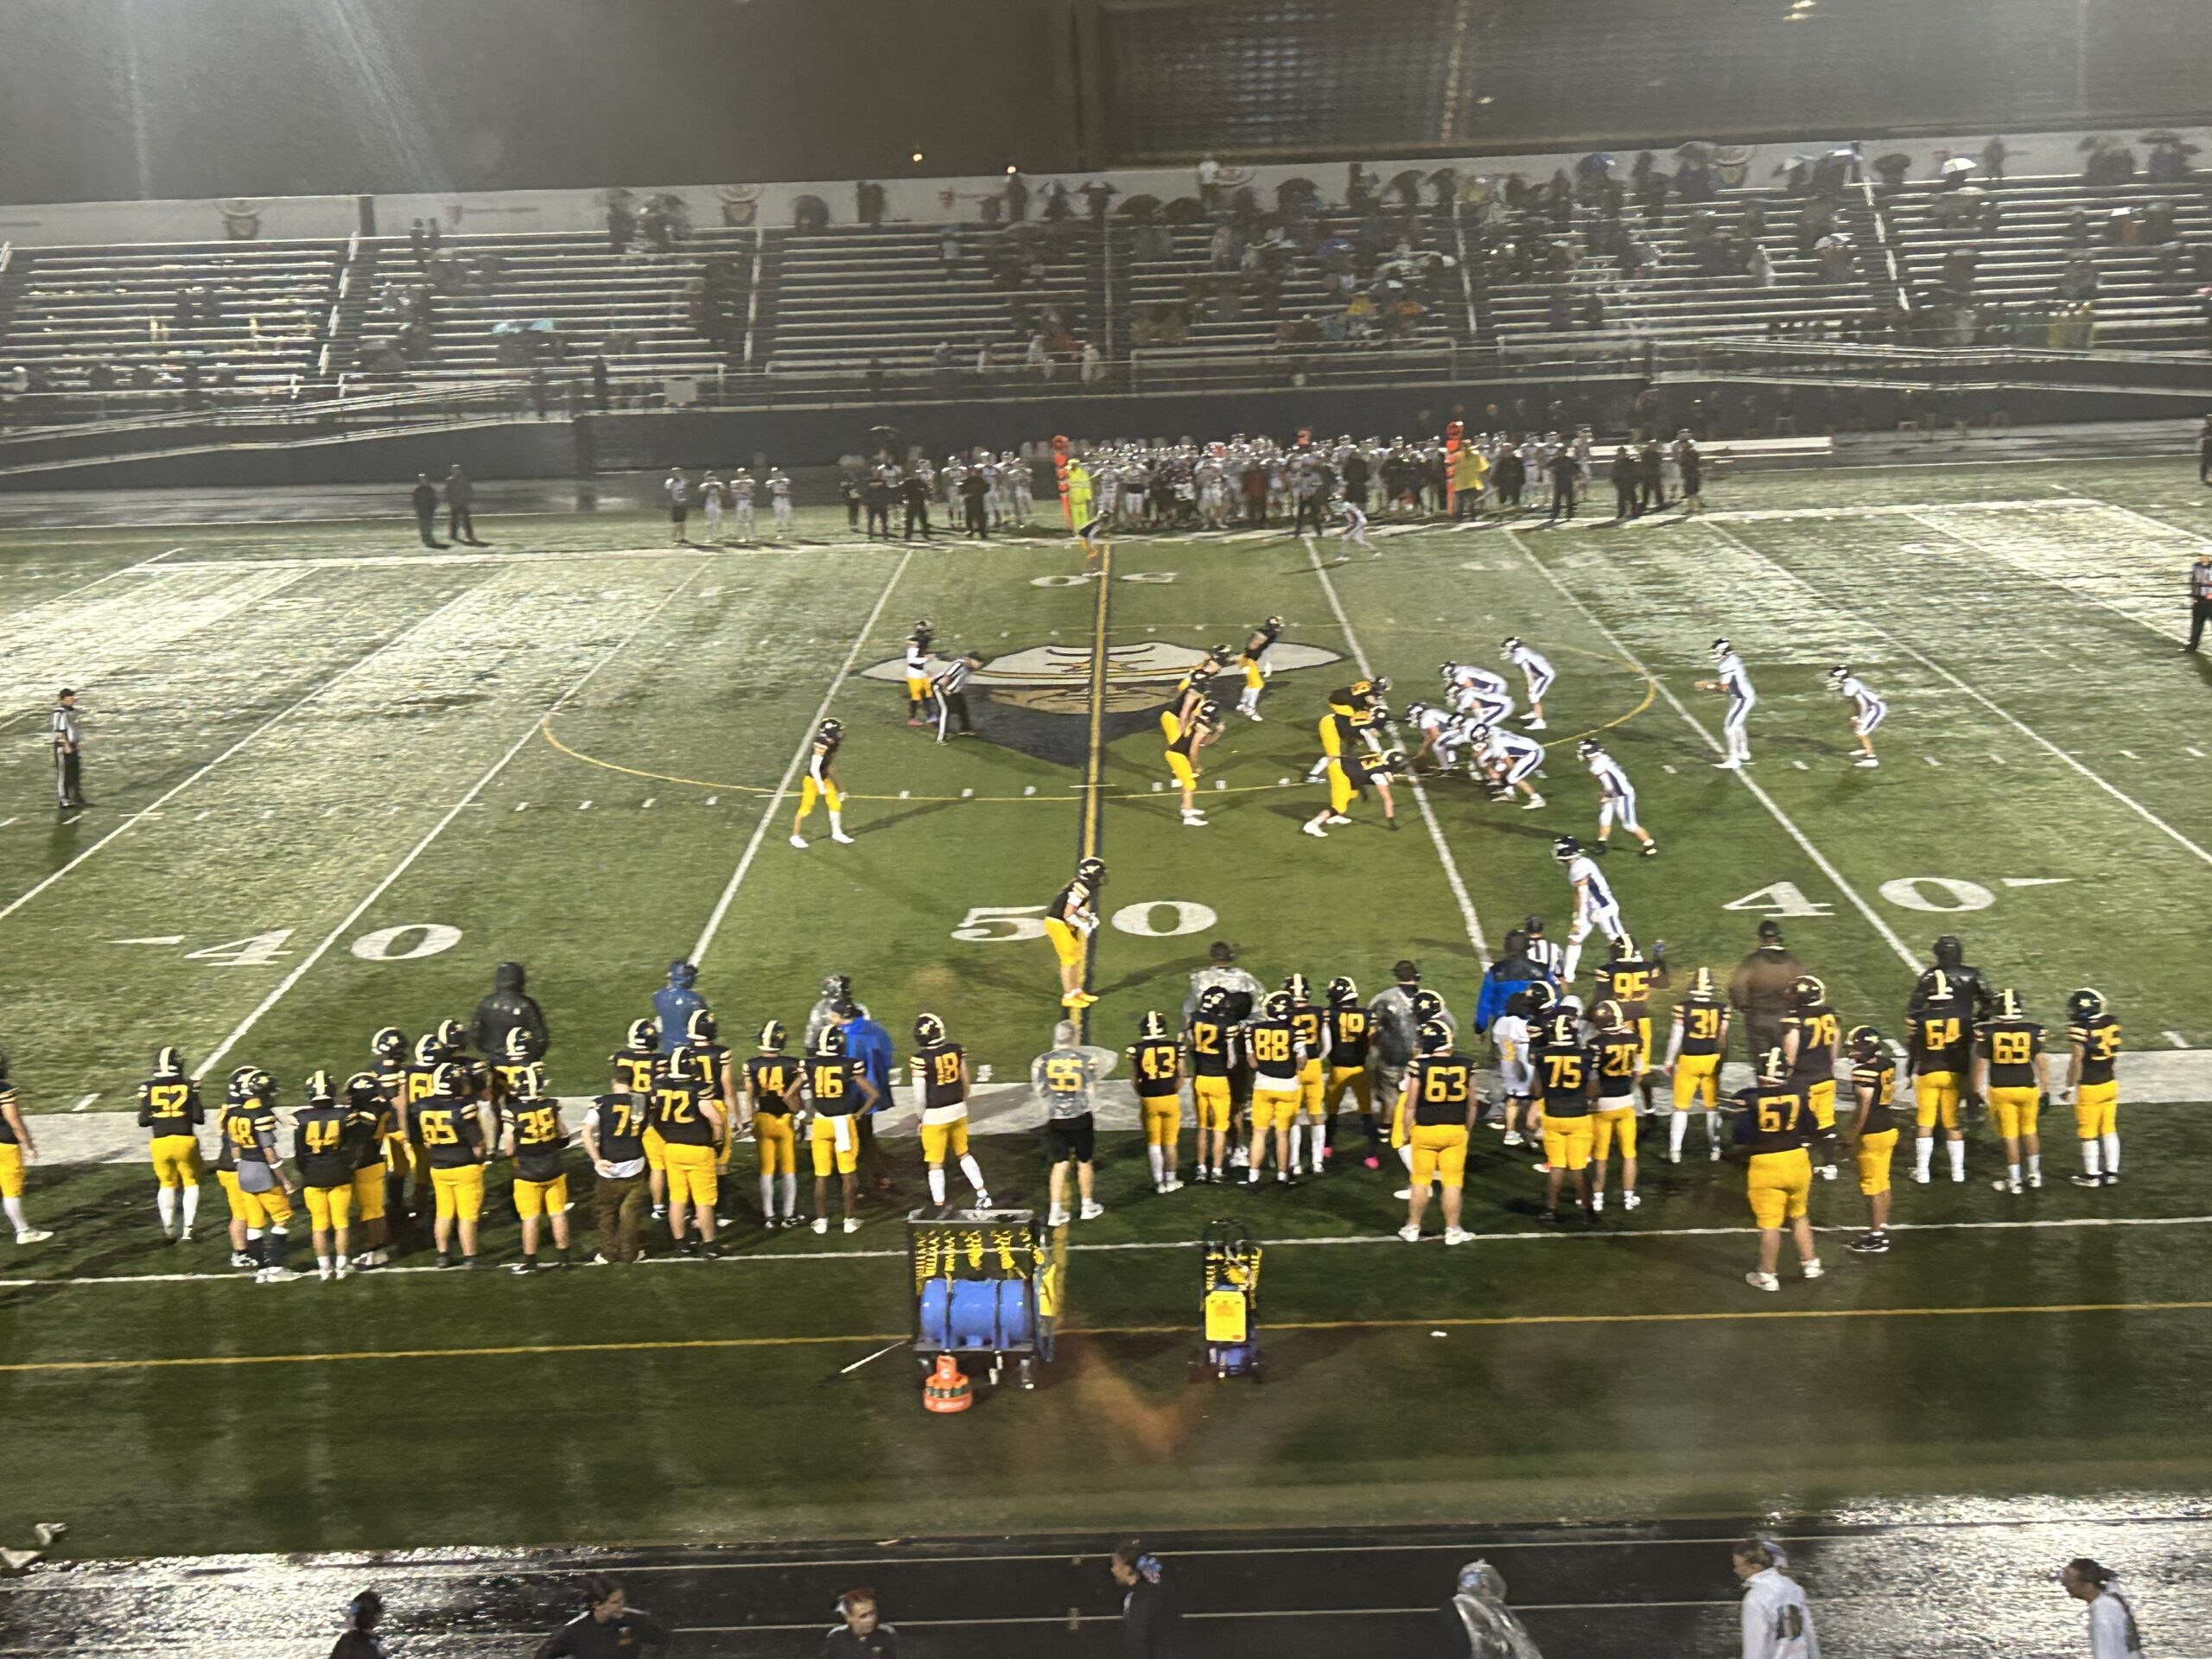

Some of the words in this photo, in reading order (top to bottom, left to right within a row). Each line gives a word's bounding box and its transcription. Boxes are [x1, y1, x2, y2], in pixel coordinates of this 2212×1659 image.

[1688, 1009, 1718, 1039] 31
[1254, 1028, 1289, 1061] 88
[1047, 1058, 1083, 1091] 55
[1141, 1046, 1175, 1080] 43
[1544, 1055, 1581, 1089] 75
[815, 1066, 844, 1097] 16
[1424, 1065, 1467, 1103] 63
[150, 1085, 188, 1119] 52
[657, 1089, 695, 1124] 72
[1758, 1094, 1800, 1132] 67
[419, 1110, 458, 1146] 65
[518, 1107, 557, 1144] 38
